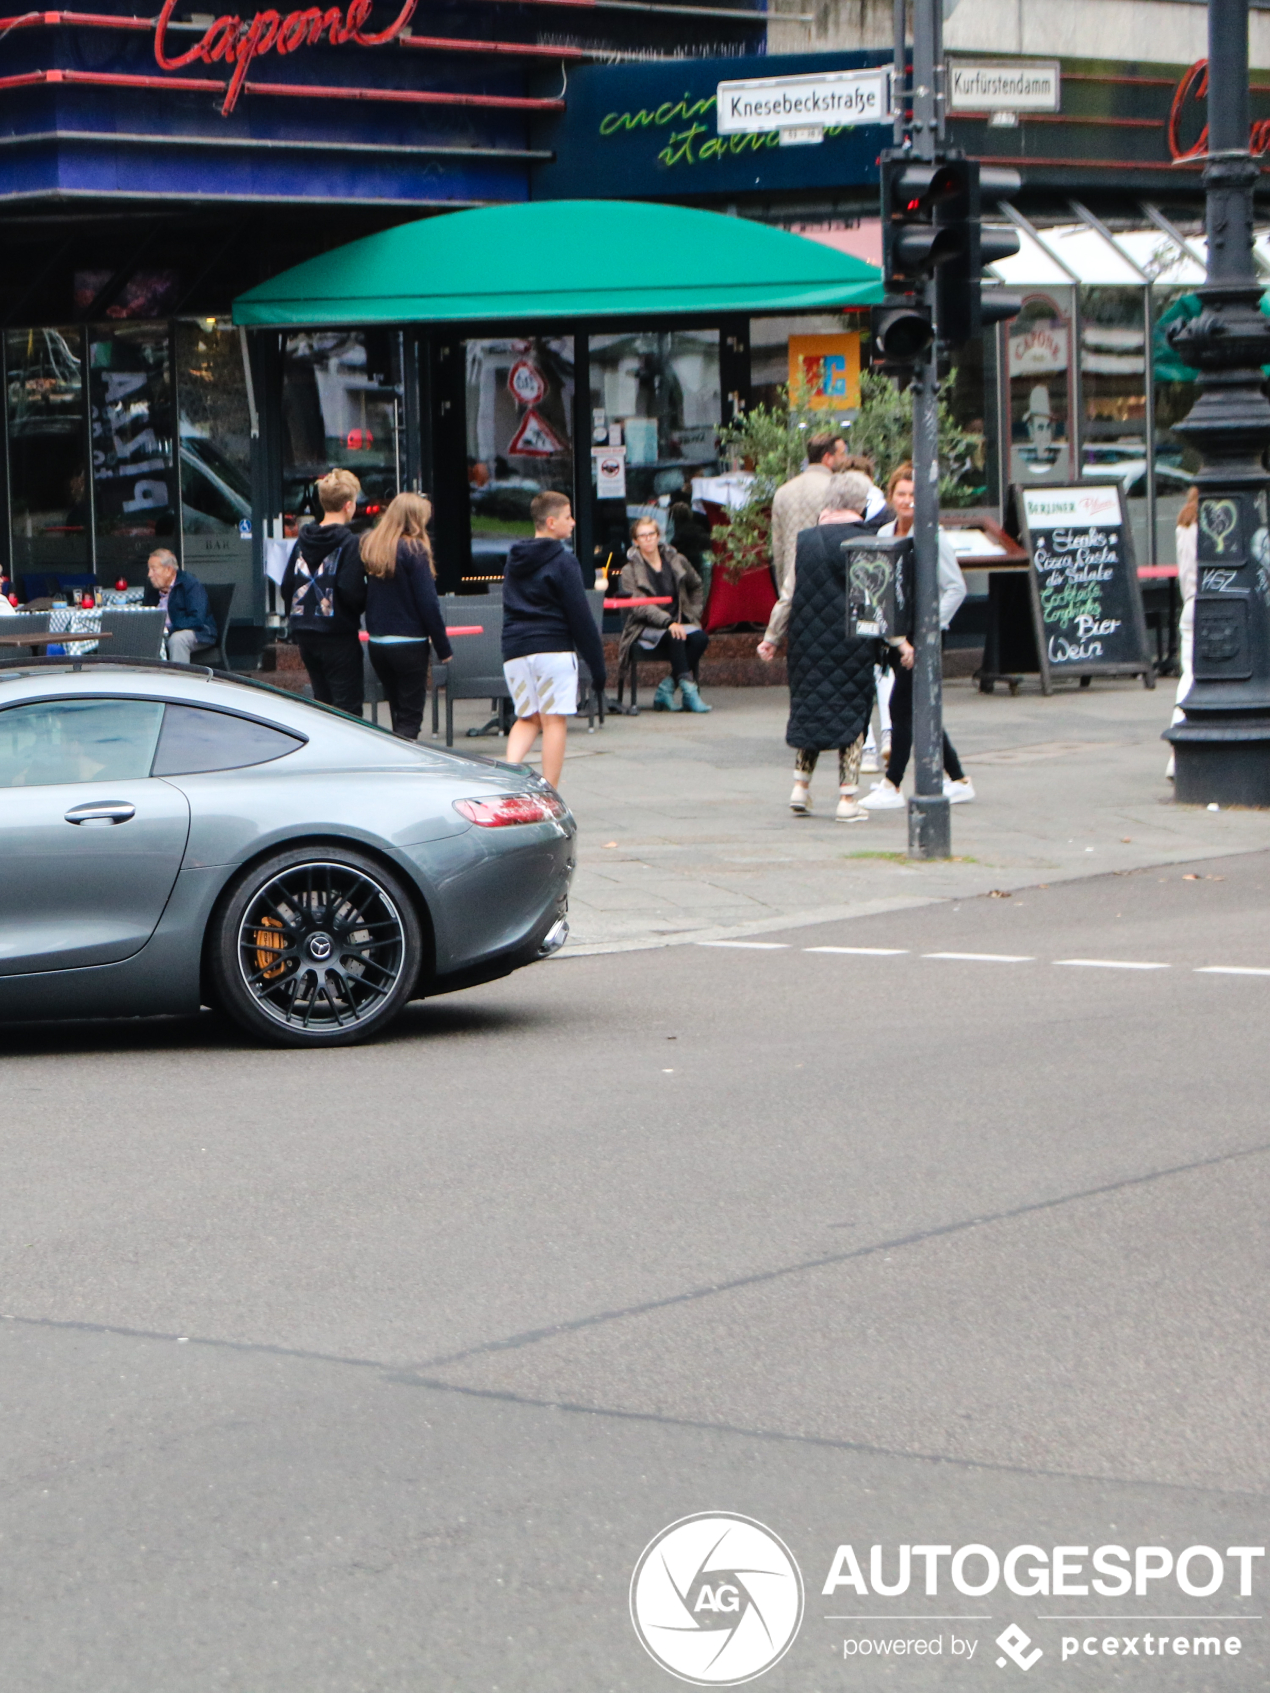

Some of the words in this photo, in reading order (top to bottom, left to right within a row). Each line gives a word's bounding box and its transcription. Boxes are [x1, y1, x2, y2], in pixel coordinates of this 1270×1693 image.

[954, 71, 1050, 95] Kurfürstendamm
[731, 88, 876, 118] Knesebeckstraße
[1028, 502, 1076, 516] BERLINER
[1052, 527, 1107, 552] Steaks
[1076, 546, 1119, 568] Pasta
[1074, 613, 1121, 638] Bier
[1048, 635, 1103, 662] Wein
